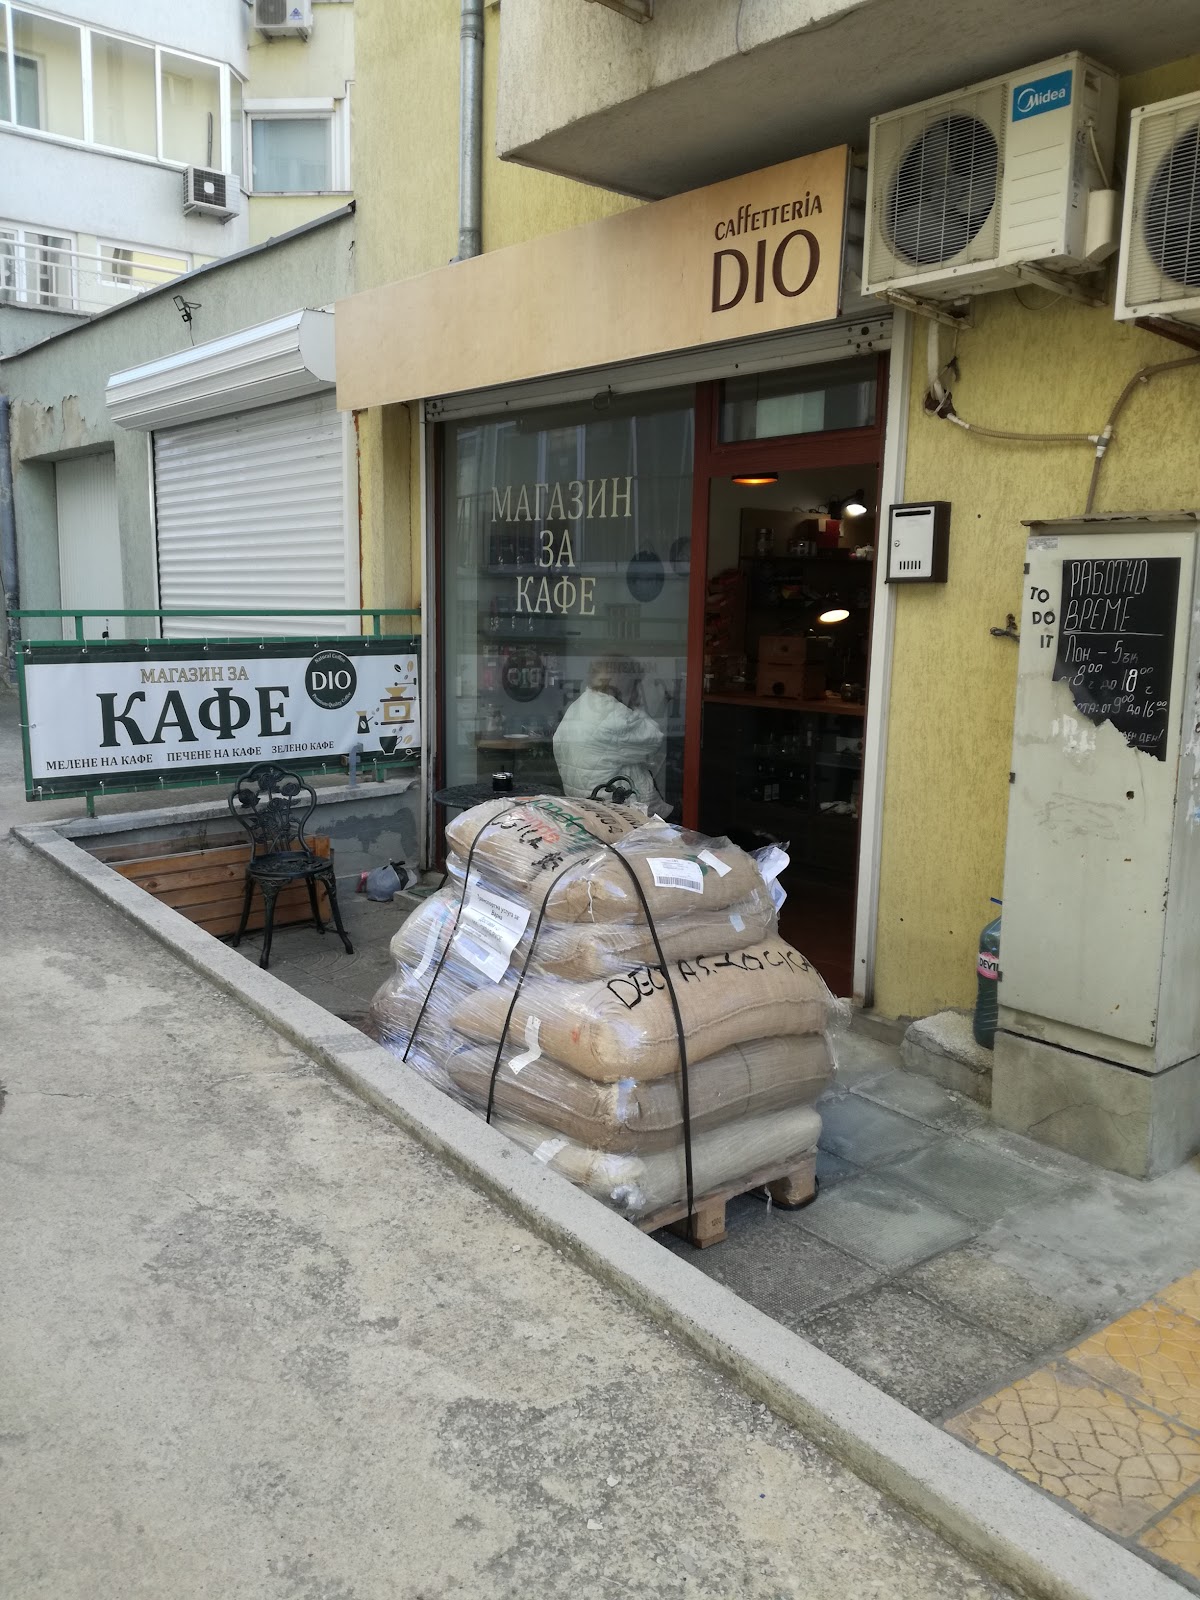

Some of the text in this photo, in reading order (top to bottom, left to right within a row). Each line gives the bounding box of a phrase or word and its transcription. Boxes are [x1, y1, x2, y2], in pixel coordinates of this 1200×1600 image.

[1018, 88, 1066, 112] Midea
[712, 229, 820, 313] DIO
[491, 476, 633, 522] МАГАЗИН
[539, 529, 575, 568] ЗА
[1071, 559, 1148, 597] РАБОТНО
[516, 575, 596, 615] КАФЕ
[1030, 586, 1050, 603] TO
[1032, 611, 1055, 625] DO
[1064, 597, 1134, 631] ВРЕМЕ
[1041, 635, 1054, 648] IT
[140, 666, 249, 683] МАГАЗИН ЗА
[311, 670, 352, 690] DIO
[96, 686, 291, 747] КАФЕ
[166, 746, 262, 762] ПЕЧЕНЕ НА КАФЕ
[271, 740, 334, 754] ЗЕЛЕНО КАФЕ
[46, 753, 153, 770] МЕЛЕНЕ НА КАФЕ
